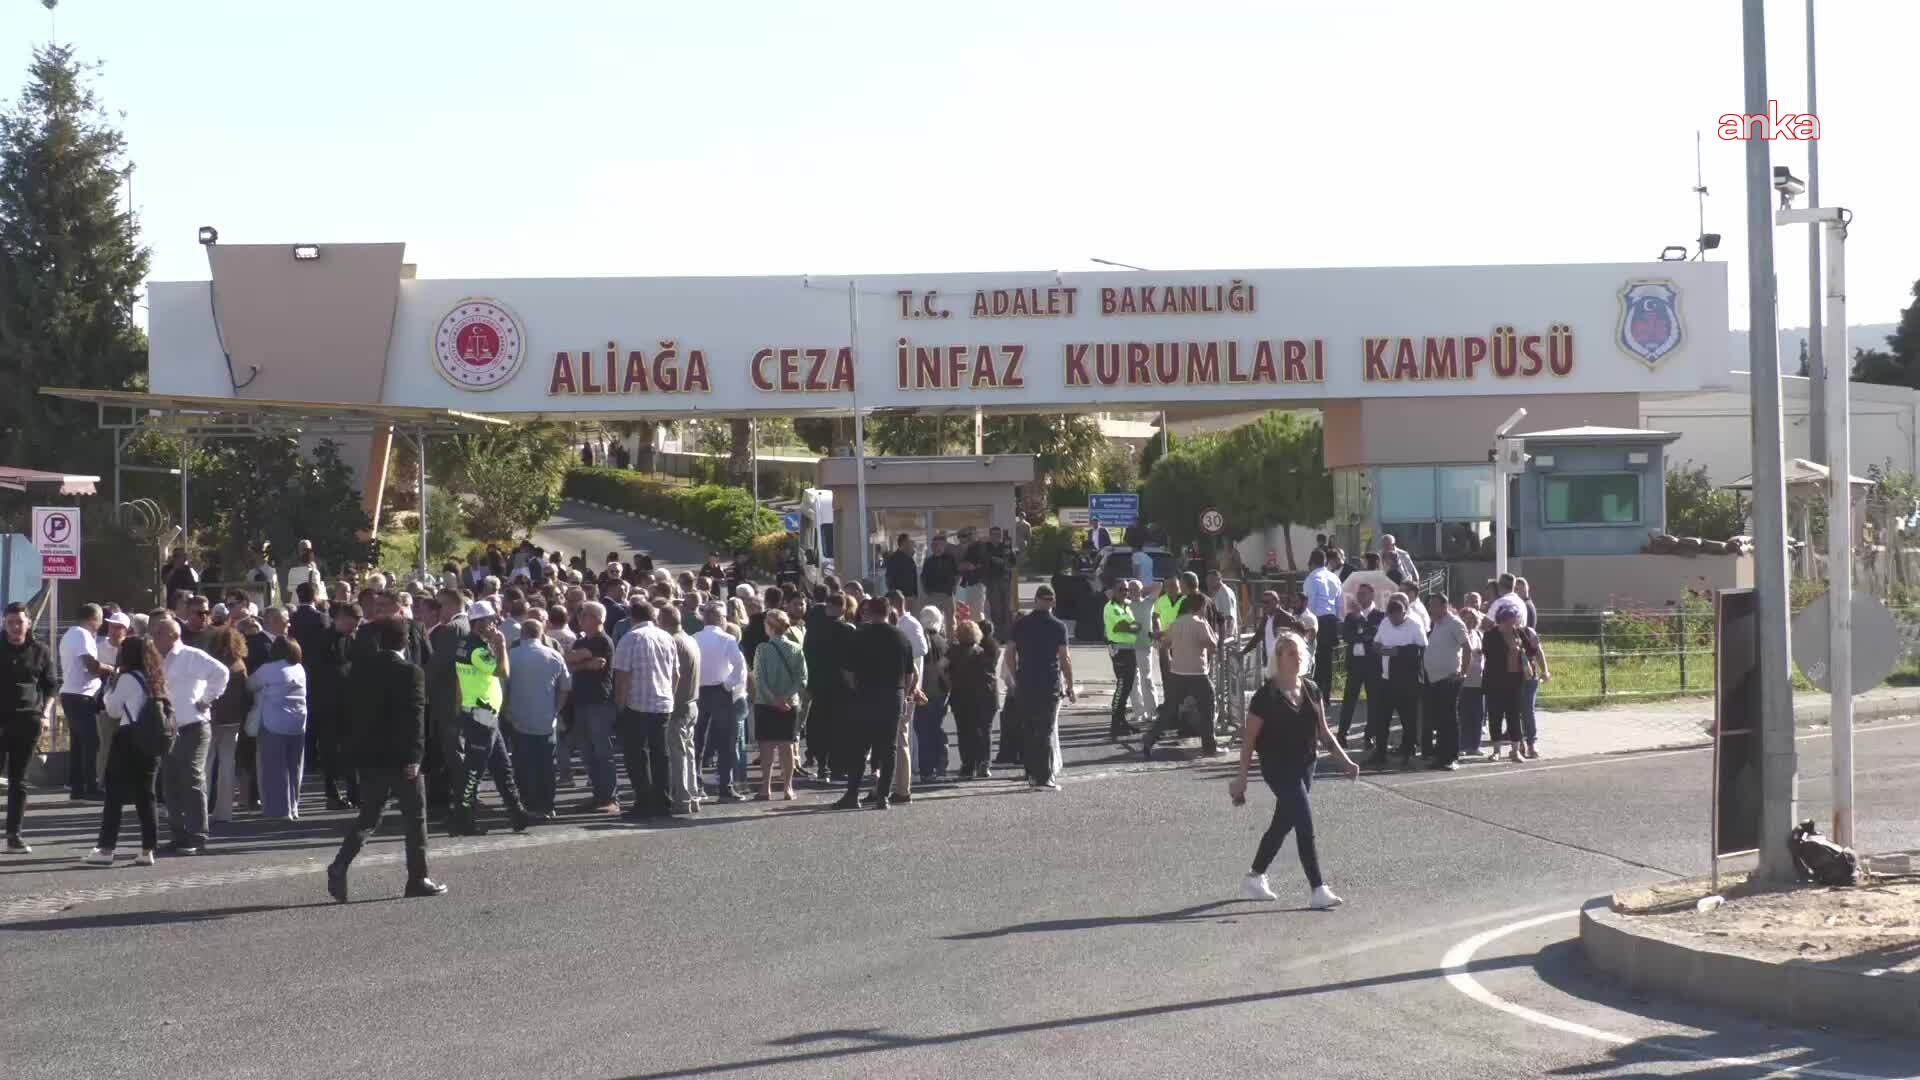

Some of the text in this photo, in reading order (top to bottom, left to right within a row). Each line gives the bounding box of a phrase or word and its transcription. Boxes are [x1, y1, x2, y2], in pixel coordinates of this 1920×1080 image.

[897, 280, 1256, 318] T.C. ADALET BAKANLIĞI
[549, 339, 711, 394] ALİAĞA
[750, 346, 856, 392] CEZA
[897, 336, 1025, 389] İNFAZ
[1064, 339, 1324, 386] KURUMLARI
[1363, 324, 1574, 382] KAMPÜSÜ
[1205, 515, 1222, 528] 30
